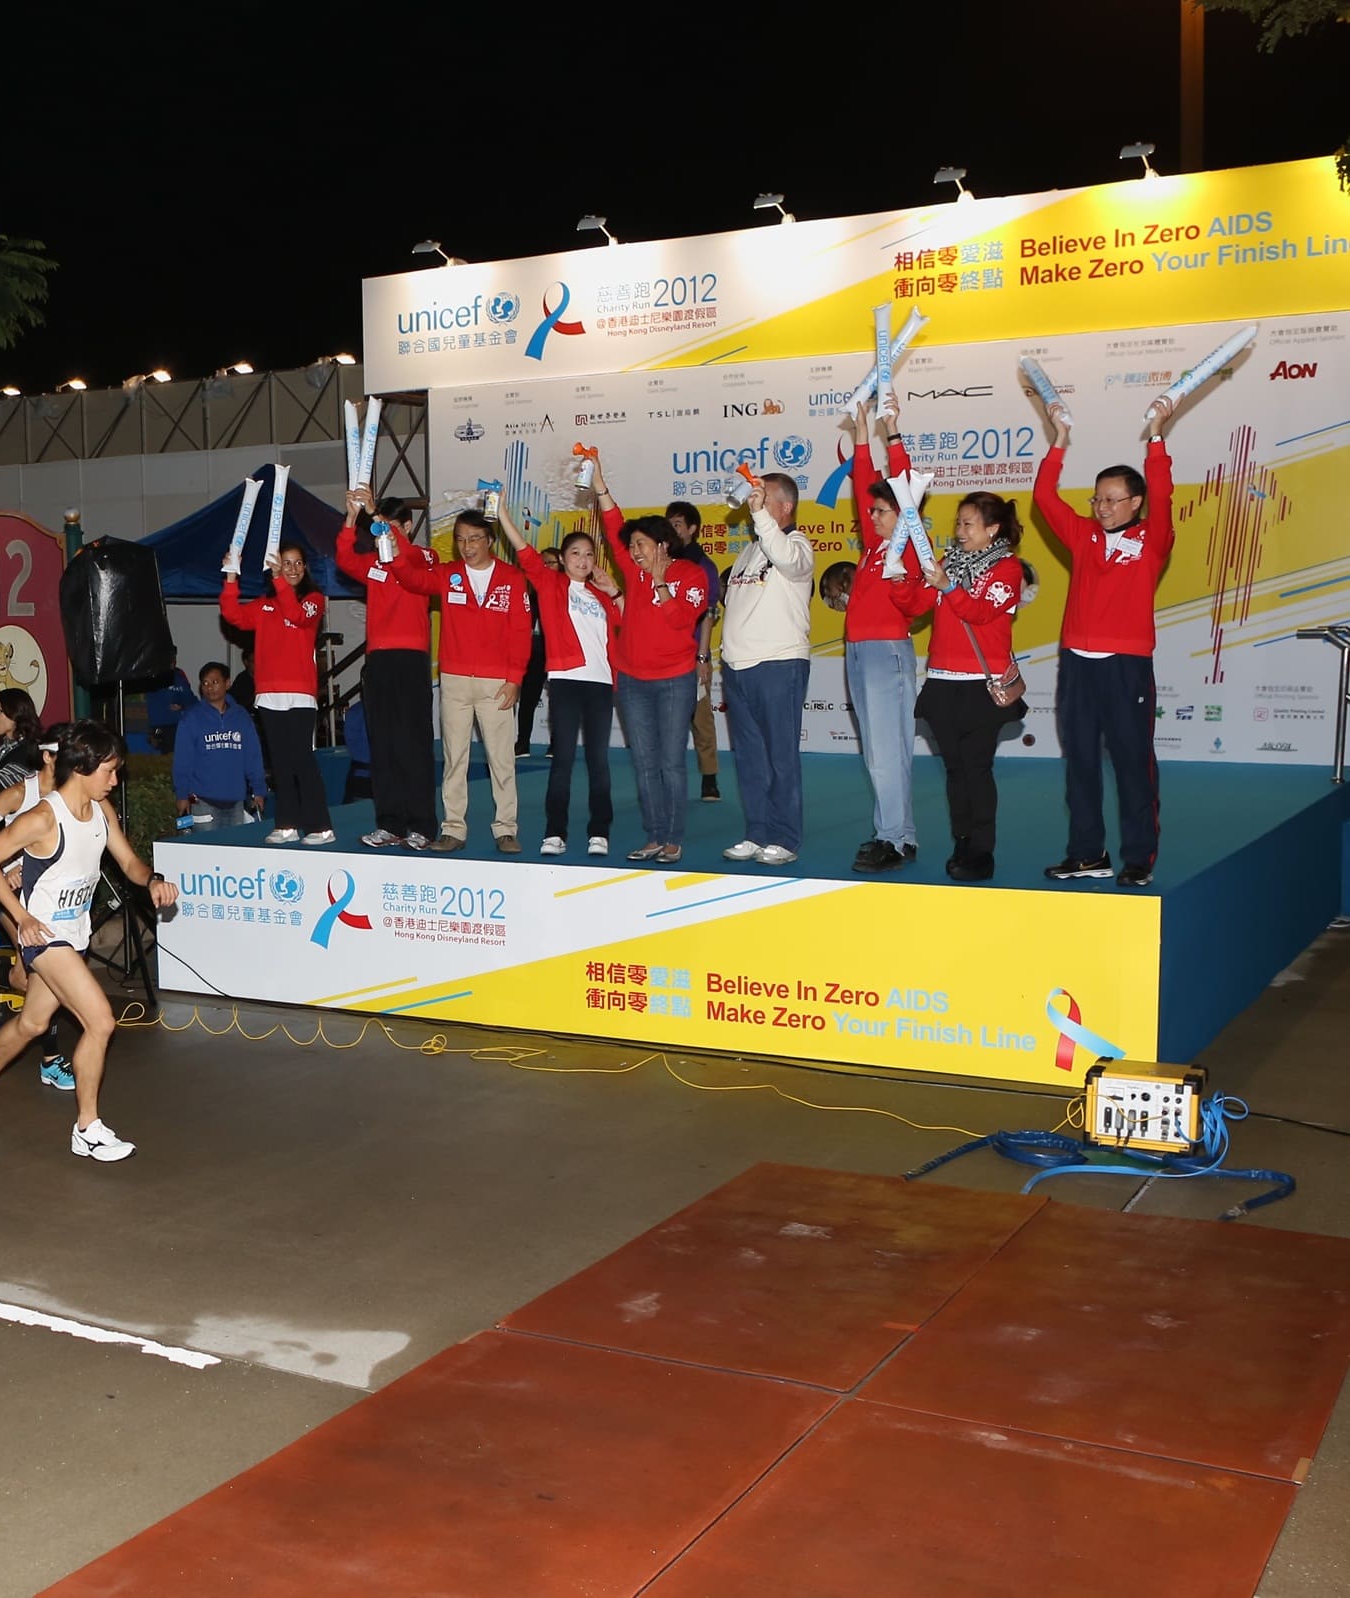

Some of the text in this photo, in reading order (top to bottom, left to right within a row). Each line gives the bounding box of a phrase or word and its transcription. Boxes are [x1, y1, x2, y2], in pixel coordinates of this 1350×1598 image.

[1020, 211, 1273, 259] Believe In Zero AIDS
[893, 241, 1004, 272] 相信零愛滋
[1019, 262, 1082, 287] Make
[1088, 259, 1144, 281] Zero
[1150, 247, 1210, 272] Your
[1217, 238, 1298, 266] Finish
[653, 273, 718, 307] 2012
[893, 268, 1004, 300] 衝向零終點
[397, 295, 483, 335] unicef
[596, 301, 651, 314] Charity Run
[606, 320, 717, 337] Hong Kong Disneyland Resort
[878, 329, 891, 367] unicef
[722, 402, 759, 419] ING
[365, 432, 377, 475] unicef
[672, 437, 770, 475] unicef
[937, 451, 958, 461] Run
[961, 426, 1035, 459] 2012
[933, 475, 1033, 488] Kong Disneyland Resort
[270, 508, 283, 544] unicef
[831, 520, 845, 534] In
[911, 524, 933, 561] unicef
[204, 730, 232, 743] unicef
[180, 866, 266, 901] unicef
[181, 900, 303, 927] 聯合國兒童基金會
[382, 882, 506, 919] 慈善跑 2012
[383, 901, 437, 915] Charity Run
[394, 930, 506, 946] Hong Kong Disneyland Resort
[585, 960, 692, 991] 相信零愛滋
[585, 987, 692, 1018] 衝向零終點
[706, 972, 949, 1013] Believe In Zero AIDS
[706, 1000, 1037, 1052] Make Zero Your Finish Line
